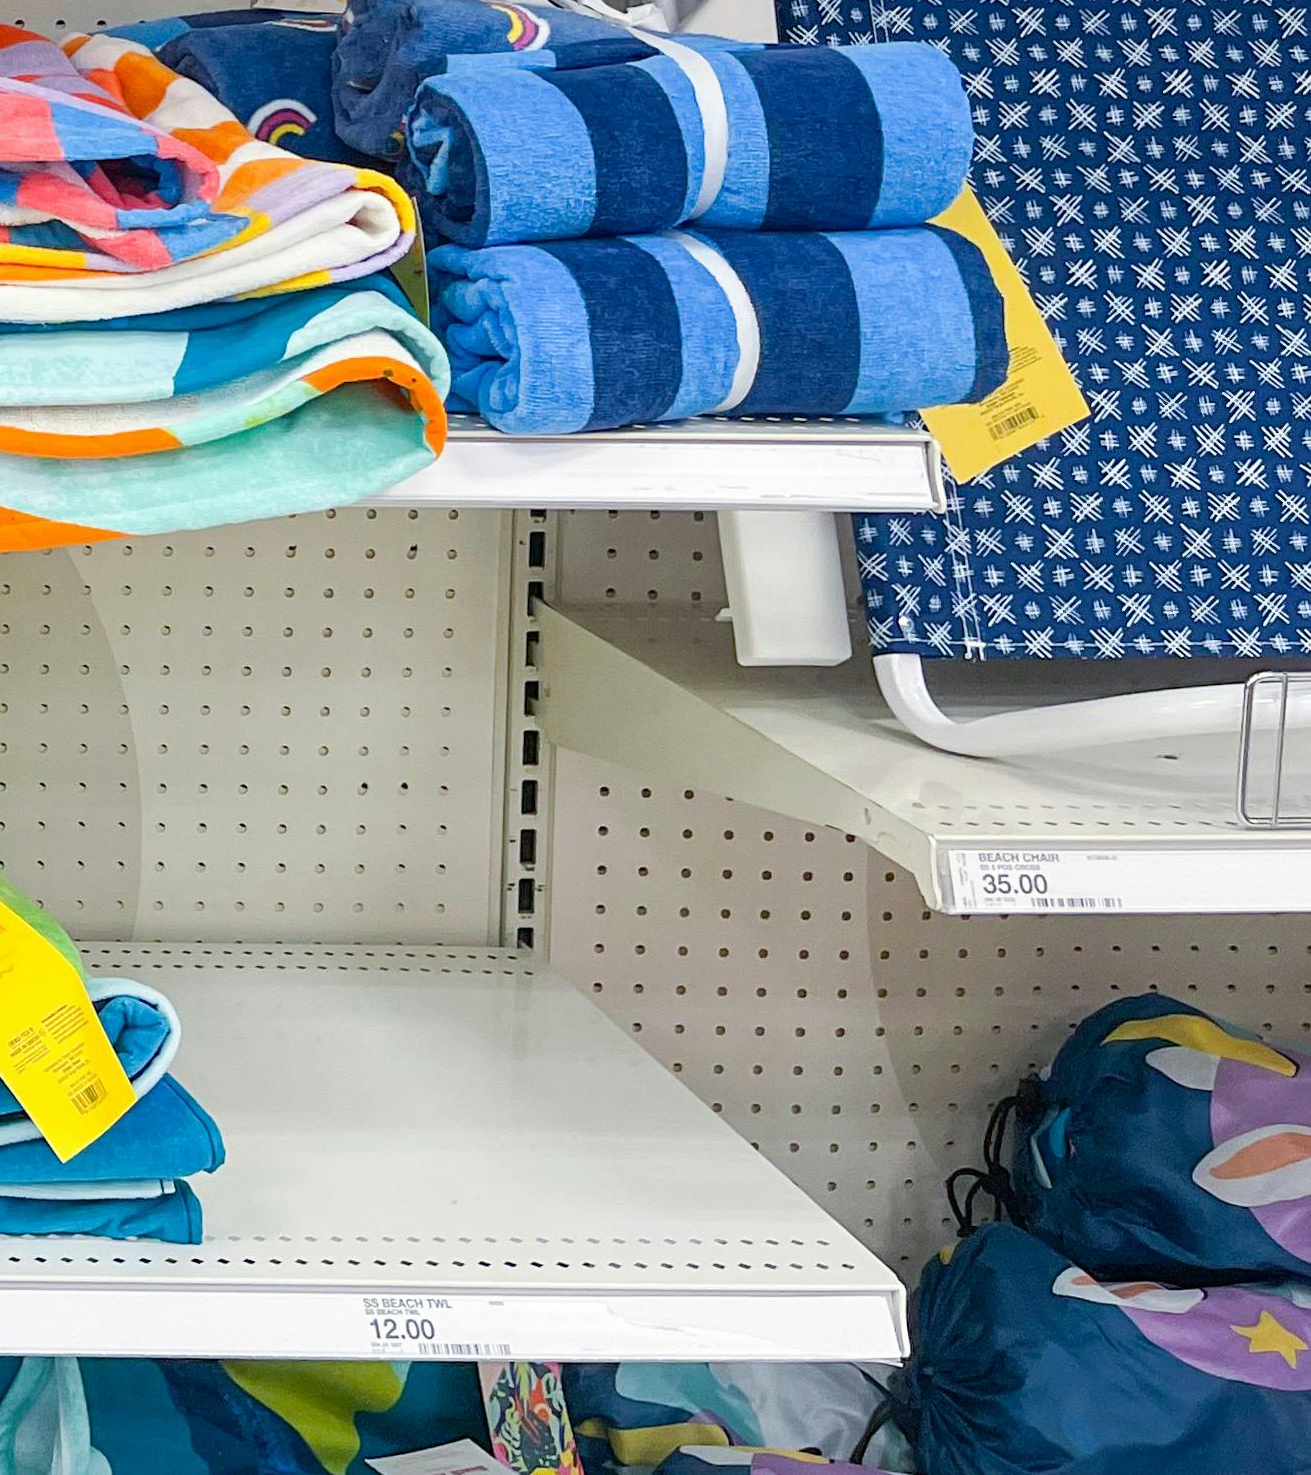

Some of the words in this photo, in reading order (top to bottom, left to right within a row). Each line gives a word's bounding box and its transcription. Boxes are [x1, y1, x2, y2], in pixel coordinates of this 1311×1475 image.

[979, 853, 1019, 863] BEACH
[1022, 853, 1060, 863] CHAIR
[982, 874, 1048, 894] 35.00
[363, 1298, 379, 1309] SS
[382, 1298, 424, 1309] BEACH
[426, 1298, 453, 1309] TWL
[370, 1318, 435, 1340] 12.00
